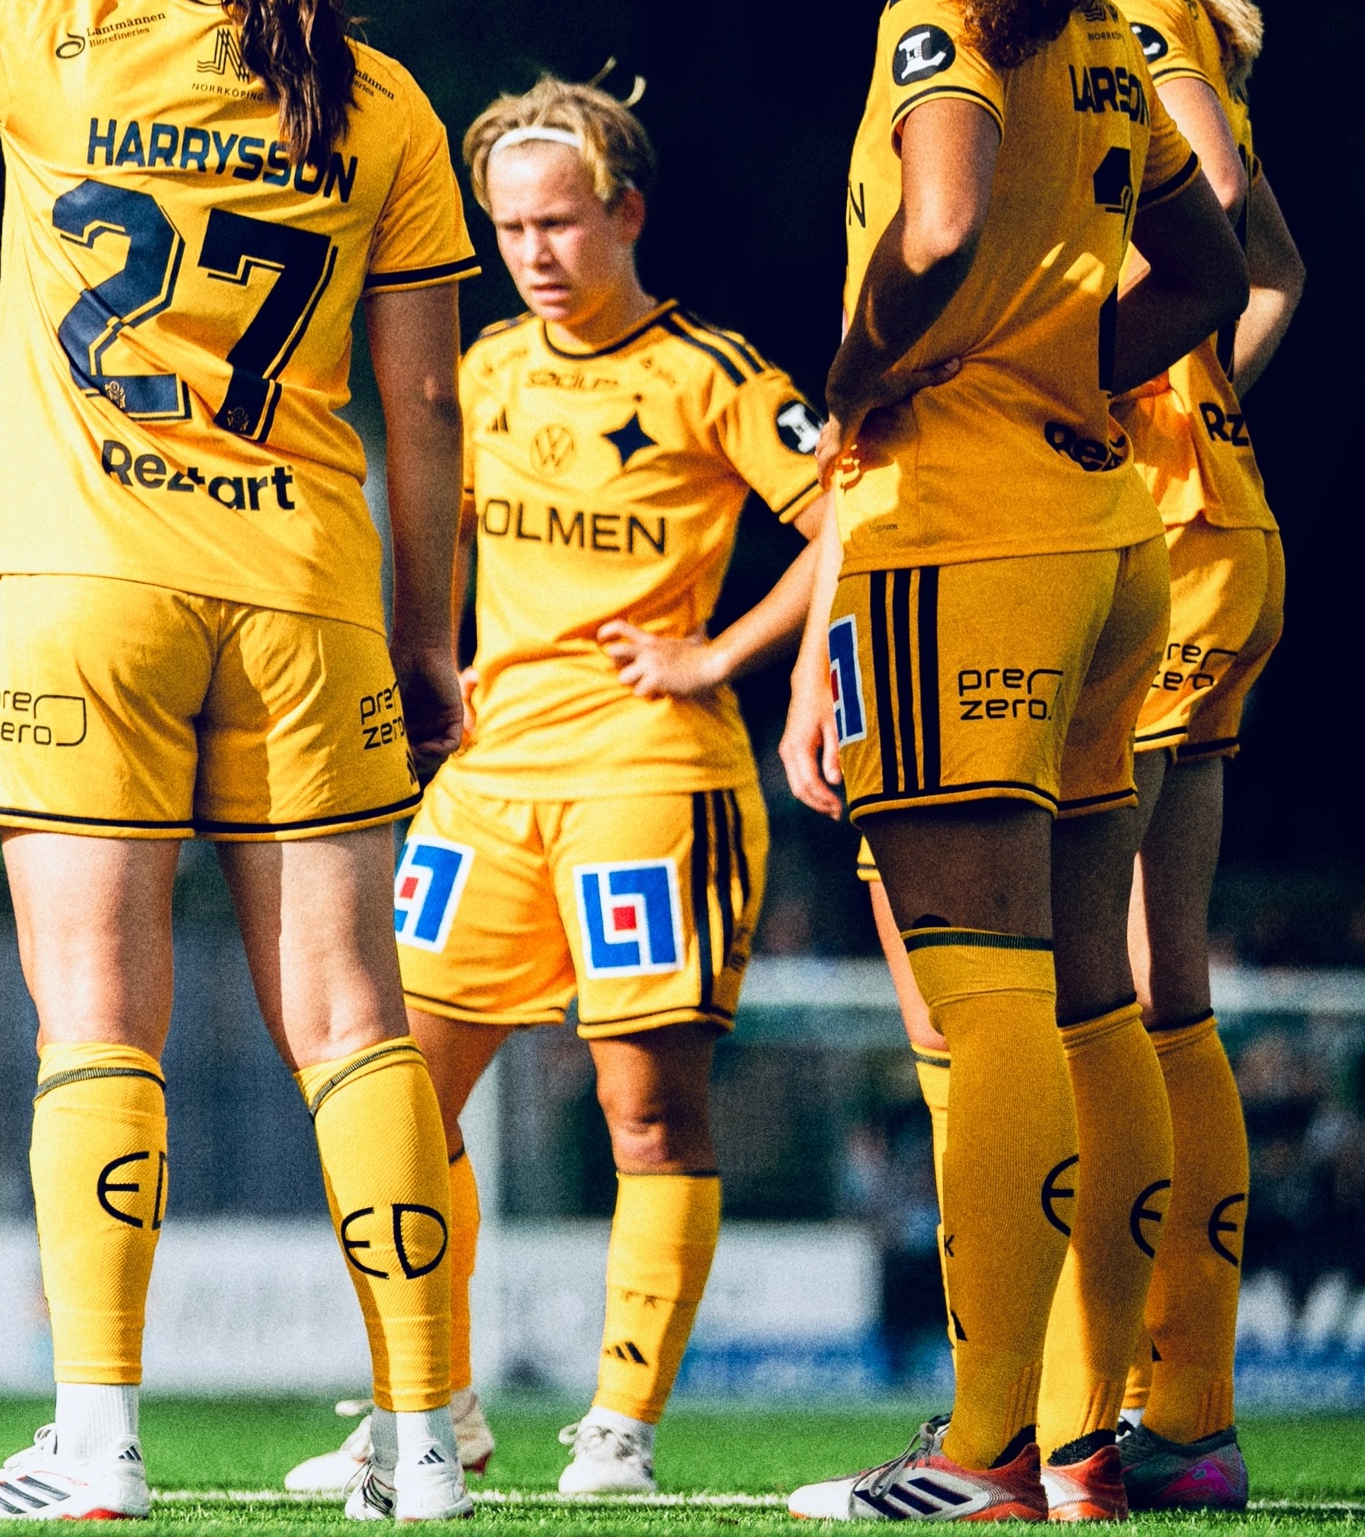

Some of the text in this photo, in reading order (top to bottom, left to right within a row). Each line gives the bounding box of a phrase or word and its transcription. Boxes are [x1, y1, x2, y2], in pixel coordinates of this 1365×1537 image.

[86, 12, 167, 38] Lantmännen
[88, 26, 151, 49] Biorefineries
[191, 82, 266, 102] NORRKÖPING
[86, 117, 359, 204] HARRYSSON
[52, 177, 339, 444] 27
[481, 498, 666, 555] OLMEN
[1167, 643, 1202, 664] re
[958, 668, 1025, 697] pre
[959, 699, 1048, 721] zero
